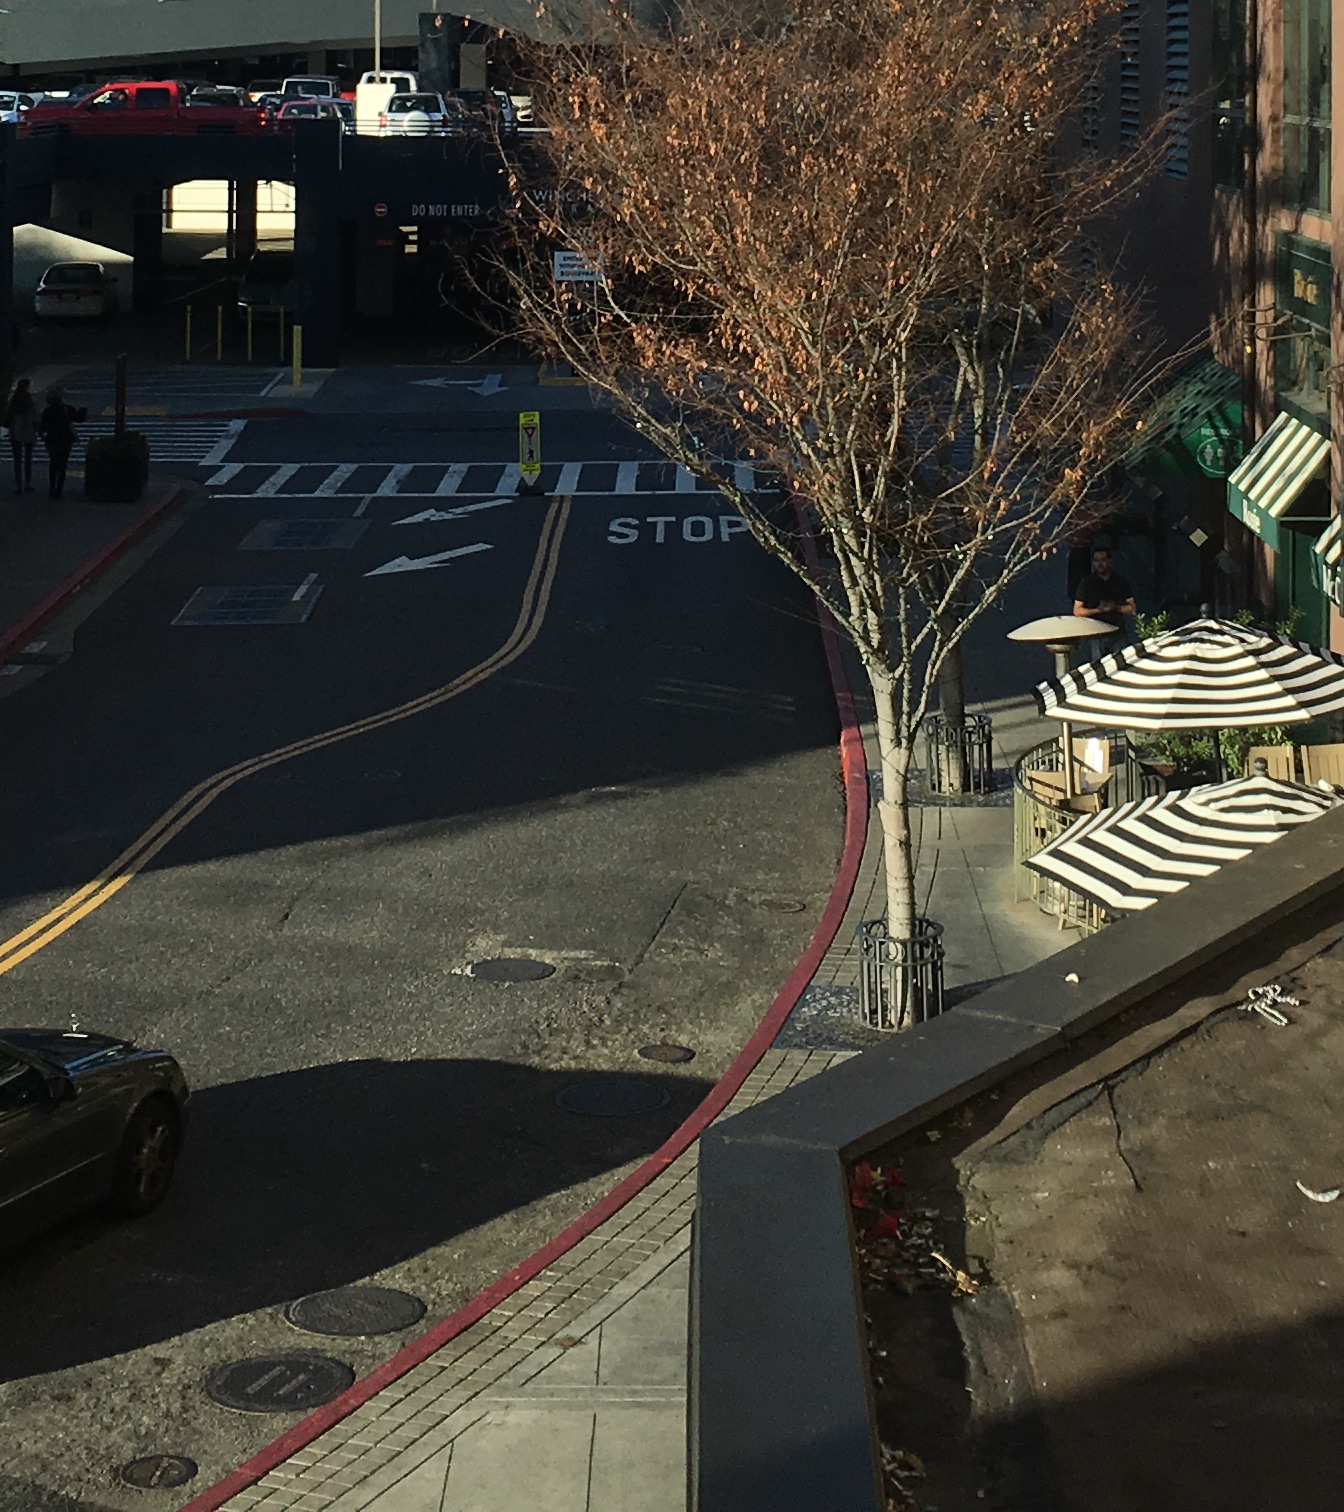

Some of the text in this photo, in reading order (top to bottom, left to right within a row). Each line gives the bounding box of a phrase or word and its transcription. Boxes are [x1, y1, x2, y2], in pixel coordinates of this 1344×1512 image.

[411, 204, 480, 217] DO NOT ENTER
[607, 515, 753, 544] STOP
